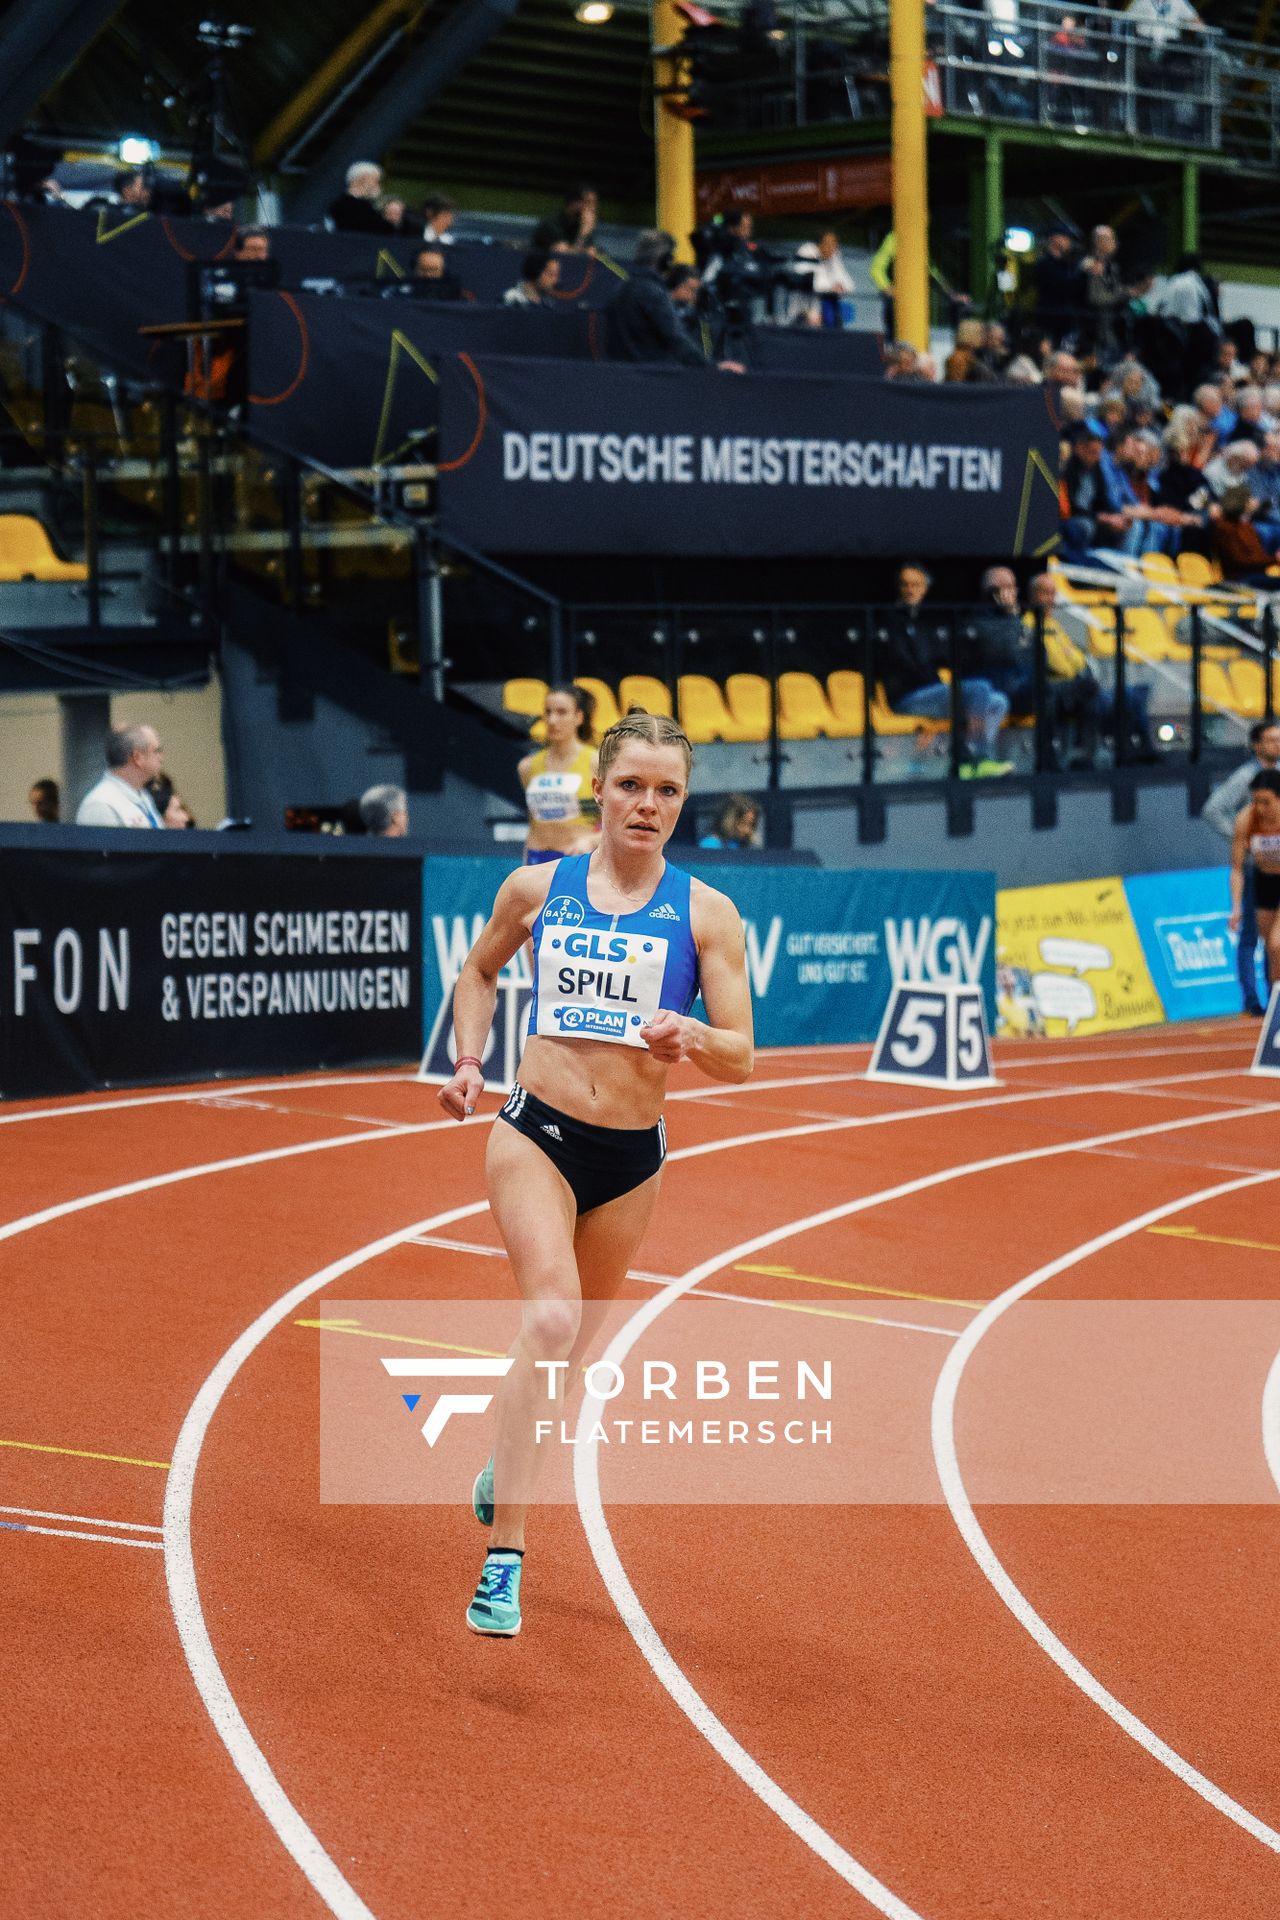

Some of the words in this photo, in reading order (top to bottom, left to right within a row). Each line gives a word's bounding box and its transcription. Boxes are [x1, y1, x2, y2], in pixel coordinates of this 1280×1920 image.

[503, 431, 693, 483] DEUTSCHE
[701, 436, 1002, 491] MEISTERSCHAFTEN
[161, 912, 247, 959] GEGEN
[254, 910, 410, 955] SCHMERZEN
[545, 910, 581, 921] BAYER
[648, 910, 680, 922] adidas
[884, 916, 993, 984] WGV
[161, 976, 180, 1021] &
[186, 967, 410, 1019] VERSPANNUNGEN
[558, 967, 638, 1003] SPILL
[585, 1024, 623, 1035] INTERNATIONAL
[586, 1011, 625, 1028] PLAN
[890, 998, 945, 1068] 5
[958, 1002, 983, 1073] 5
